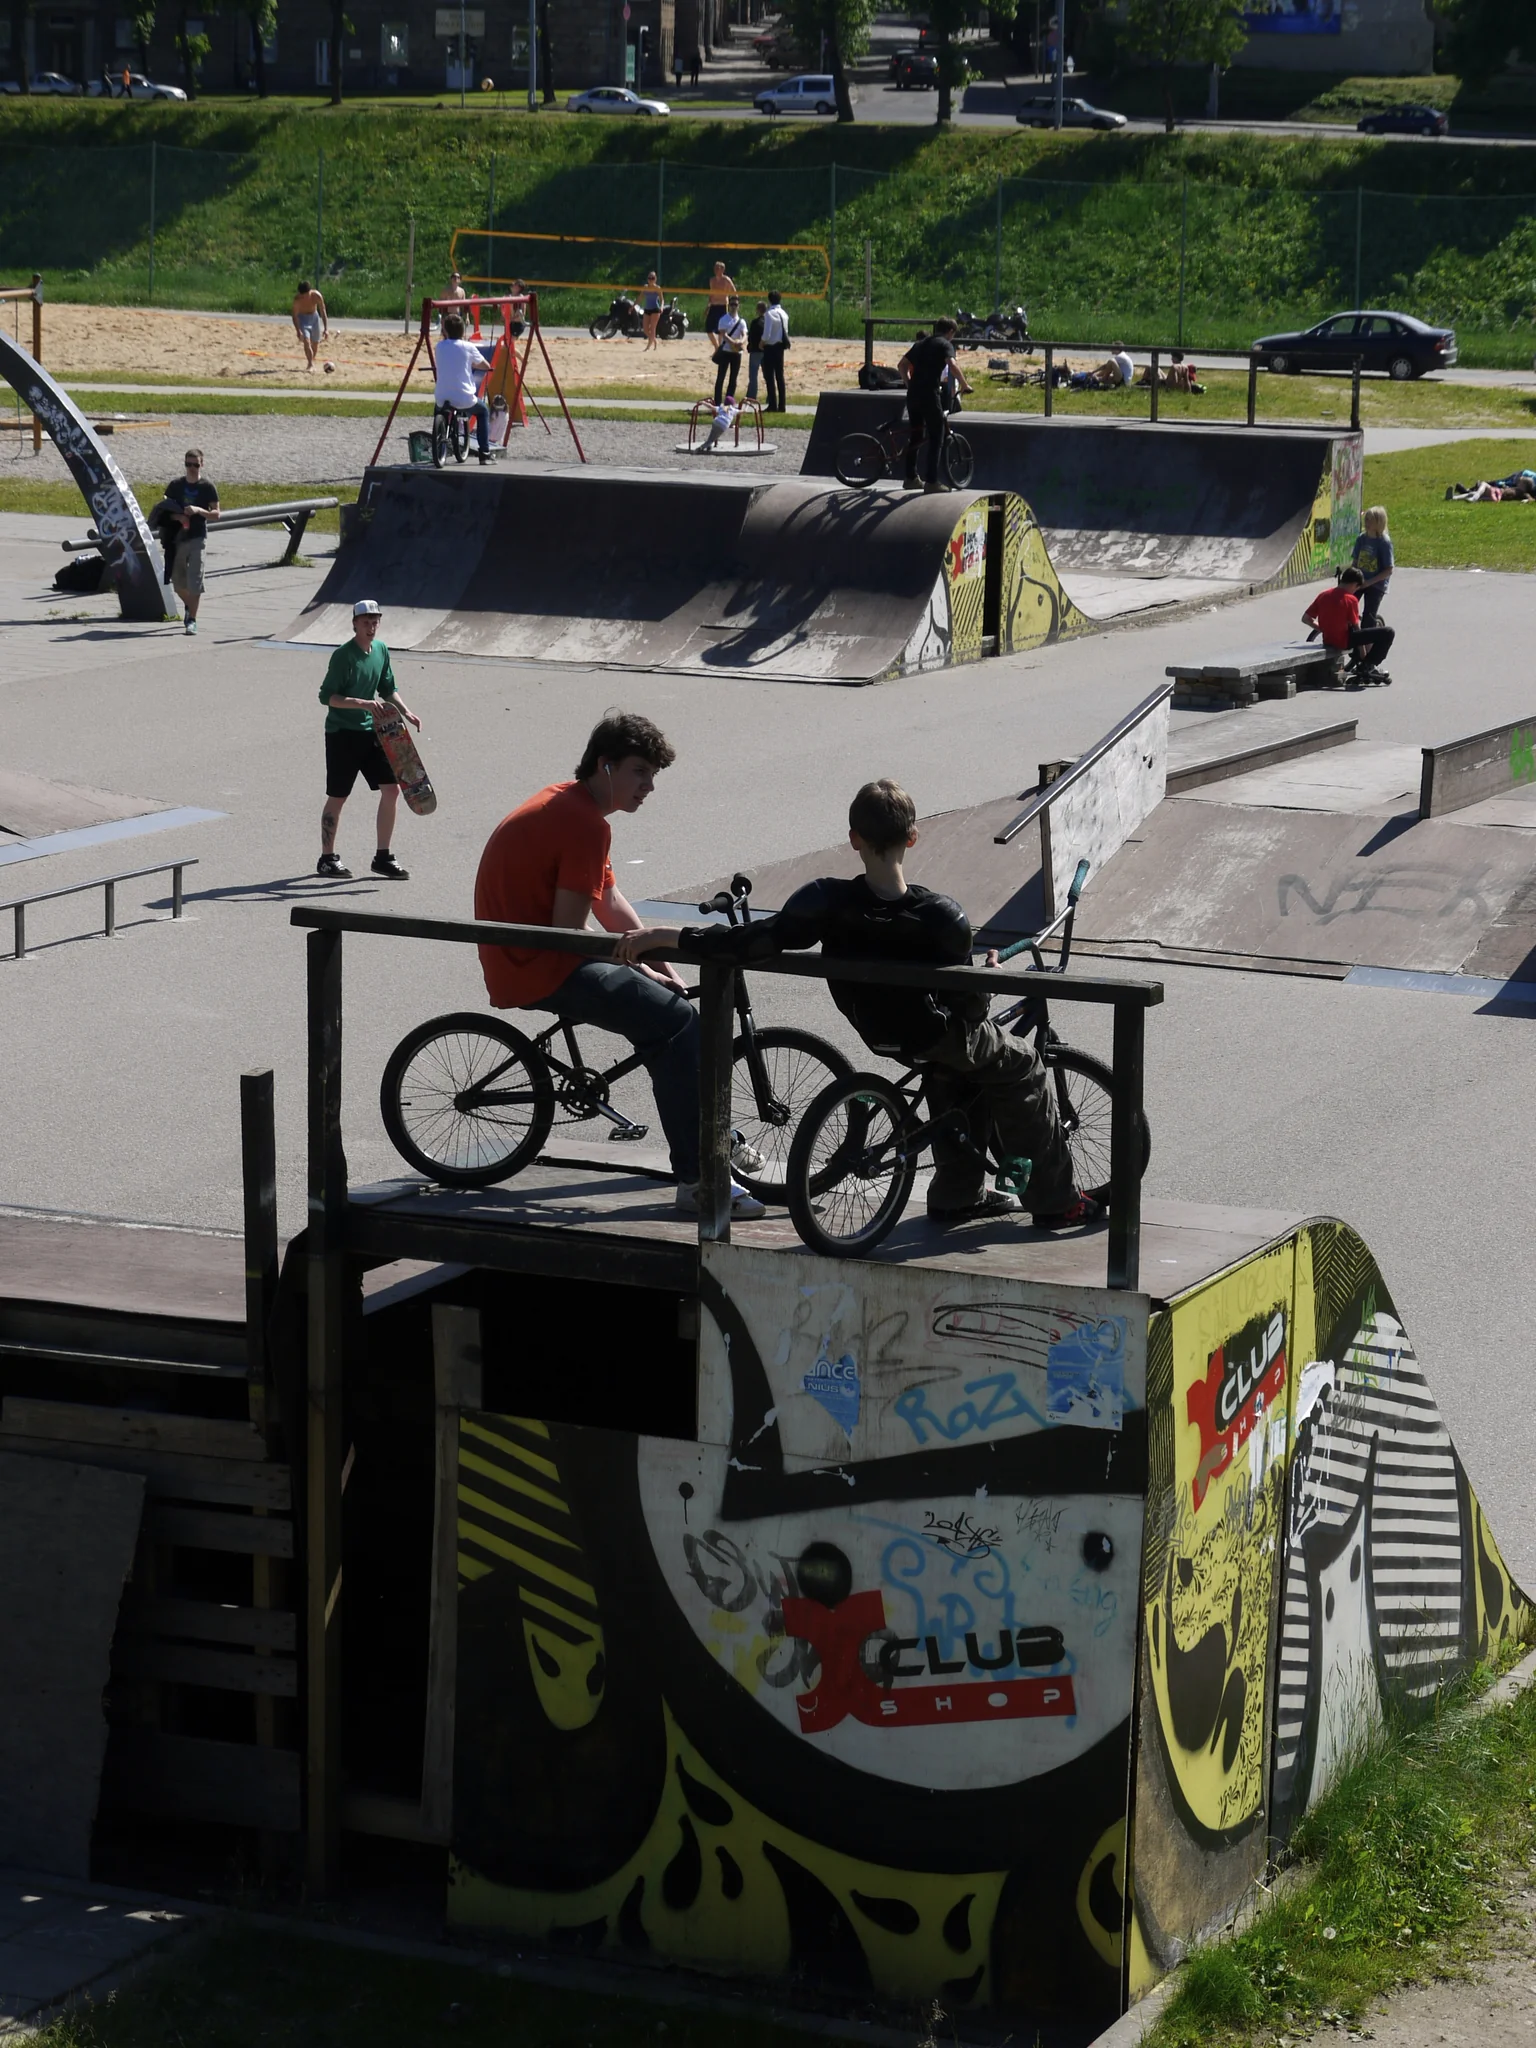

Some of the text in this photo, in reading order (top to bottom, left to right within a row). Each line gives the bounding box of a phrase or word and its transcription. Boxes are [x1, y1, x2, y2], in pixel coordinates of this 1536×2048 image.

[1221, 1312, 1284, 1420] CLUB
[806, 1382, 839, 1393] NIUS
[880, 1626, 1066, 1677] CLUB
[880, 1688, 1061, 1716] SHOP
